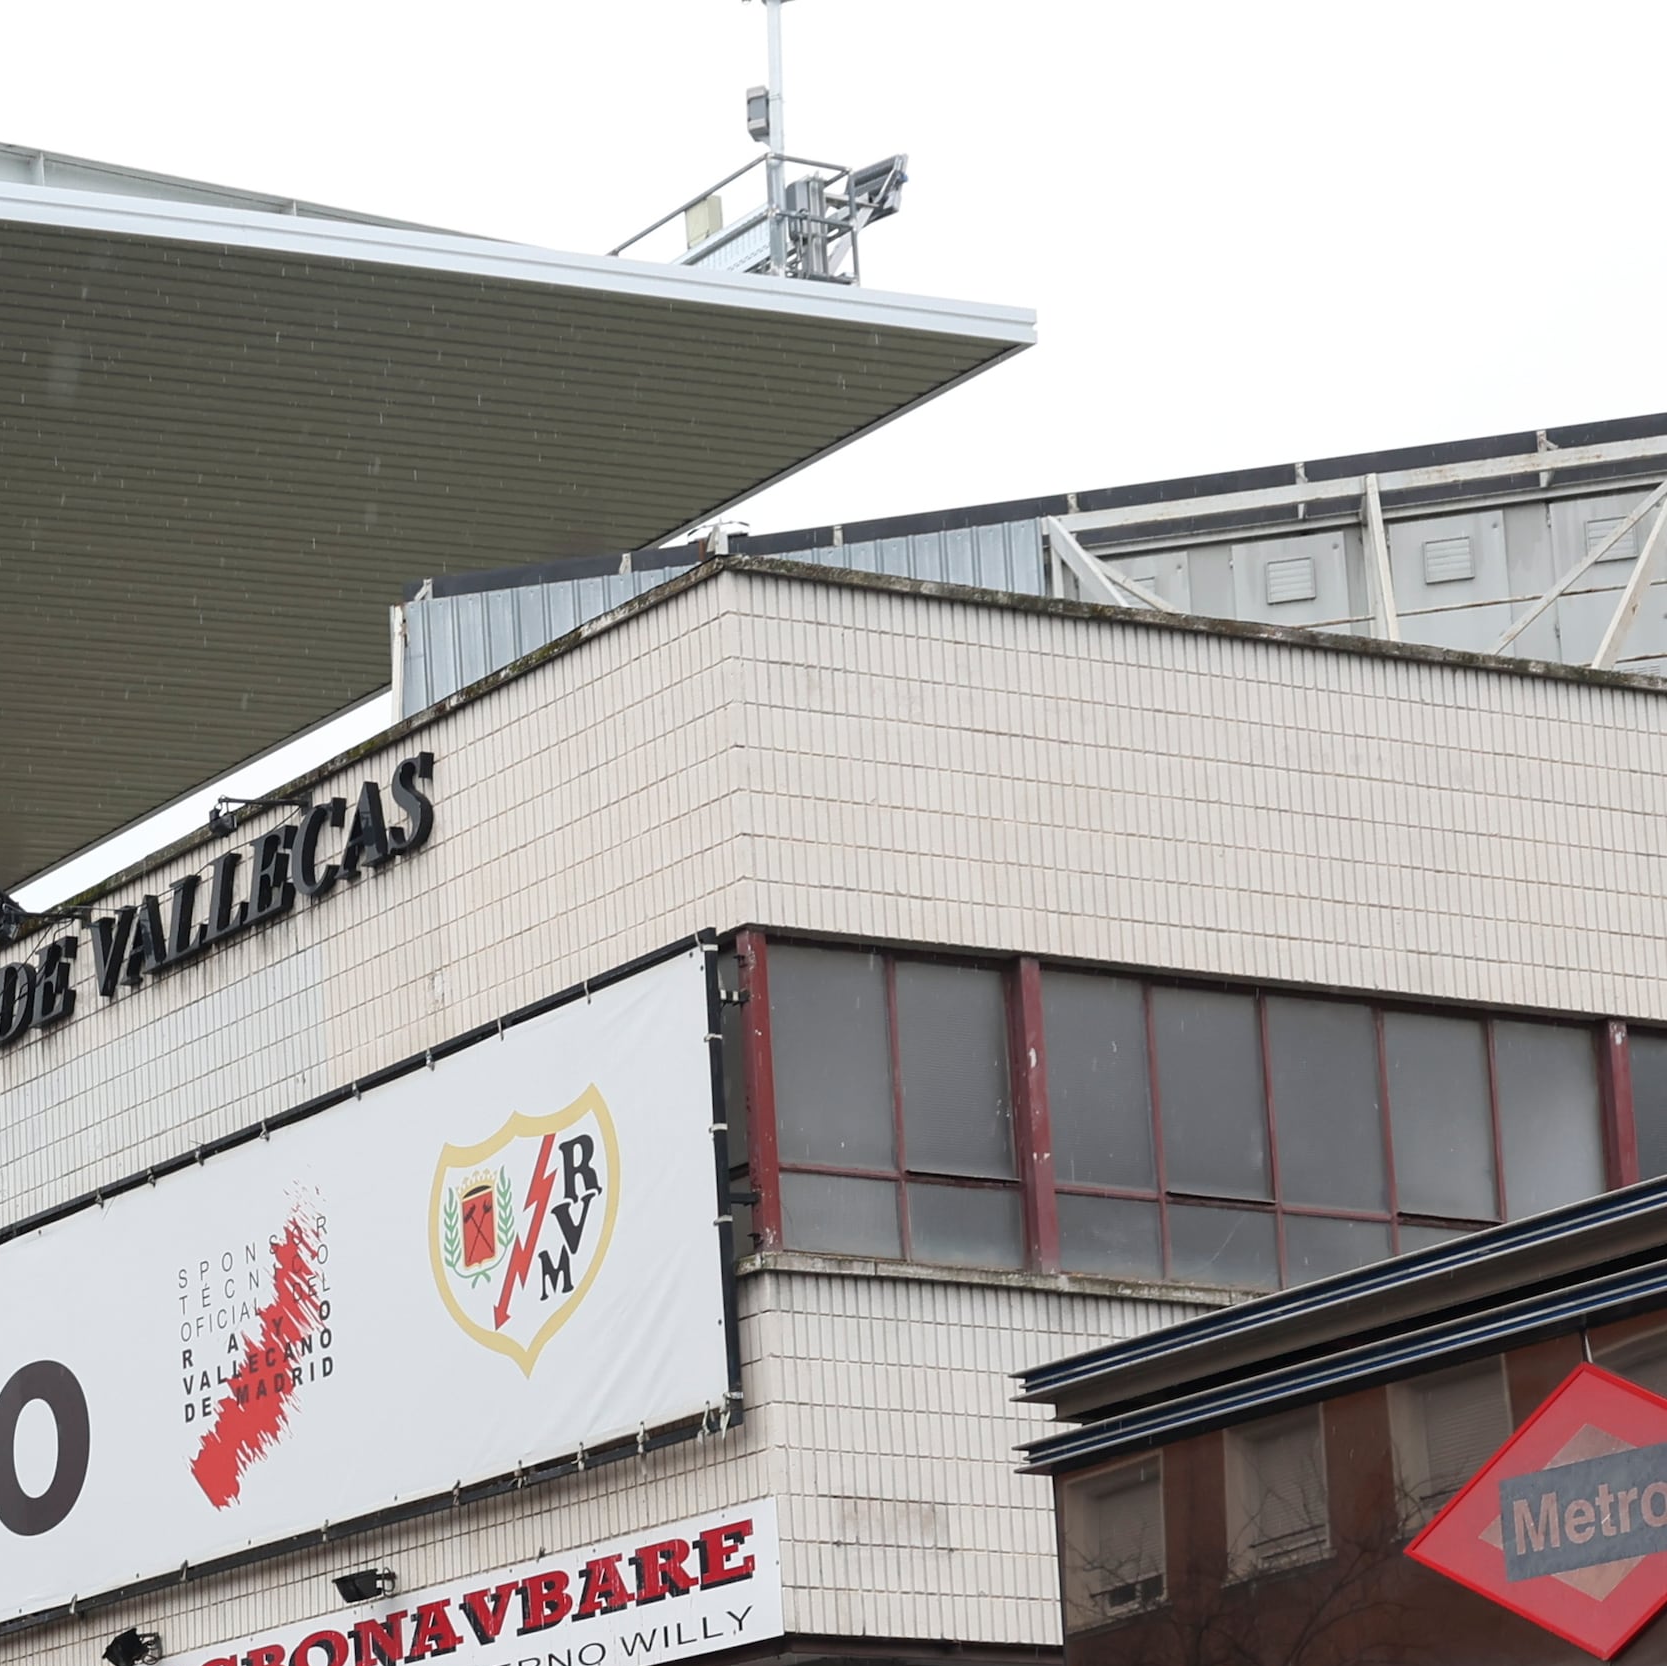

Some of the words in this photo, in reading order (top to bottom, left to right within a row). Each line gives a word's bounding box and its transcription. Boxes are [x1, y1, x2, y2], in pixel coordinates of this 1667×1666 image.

[87, 752, 434, 997] VALLECAS
[178, 1216, 328, 1289] SPONSOR
[179, 1243, 329, 1315] TÉCNICO
[180, 1297, 263, 1342] OFICIAL
[291, 1273, 331, 1304] DEL
[182, 1300, 331, 1370] RAYO
[183, 1328, 333, 1396] VALLECANO
[185, 1396, 213, 1423] DE
[235, 1356, 334, 1406] MADRID
[1512, 1482, 1667, 1556] Metro
[620, 1605, 755, 1658] WILLY
